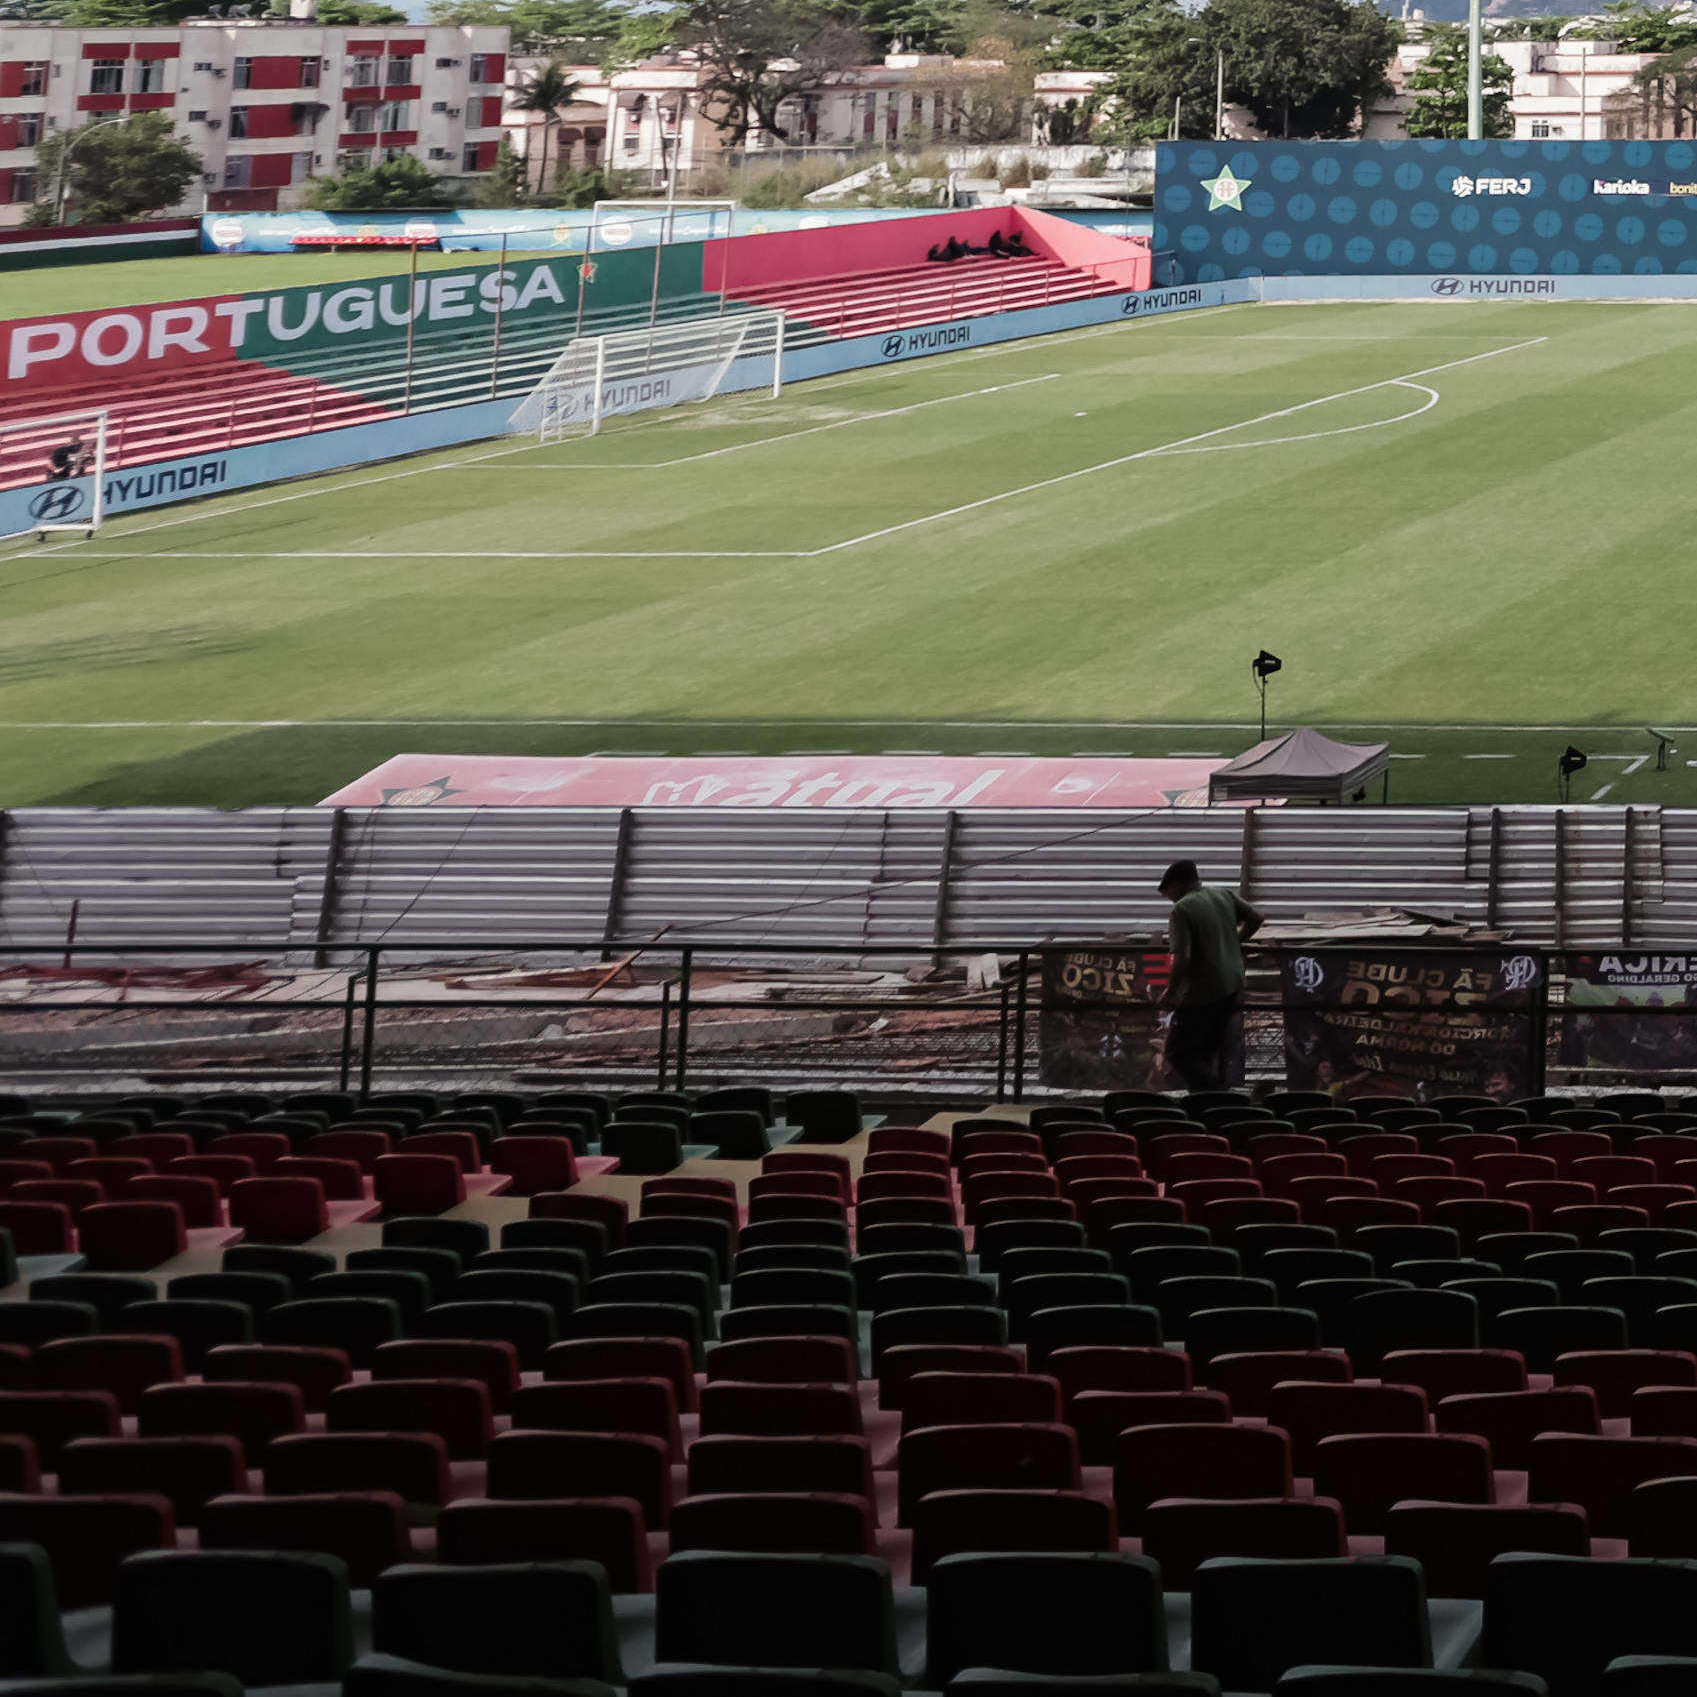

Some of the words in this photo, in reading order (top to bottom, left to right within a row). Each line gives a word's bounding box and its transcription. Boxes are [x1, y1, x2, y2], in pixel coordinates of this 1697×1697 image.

[1475, 178, 1532, 196] FERJ
[1470, 279, 1555, 294] HYUNDAI
[1144, 289, 1201, 308] HYUNDAI
[8, 265, 565, 380] PORTUGUESA
[909, 325, 970, 351] HYUNDAI
